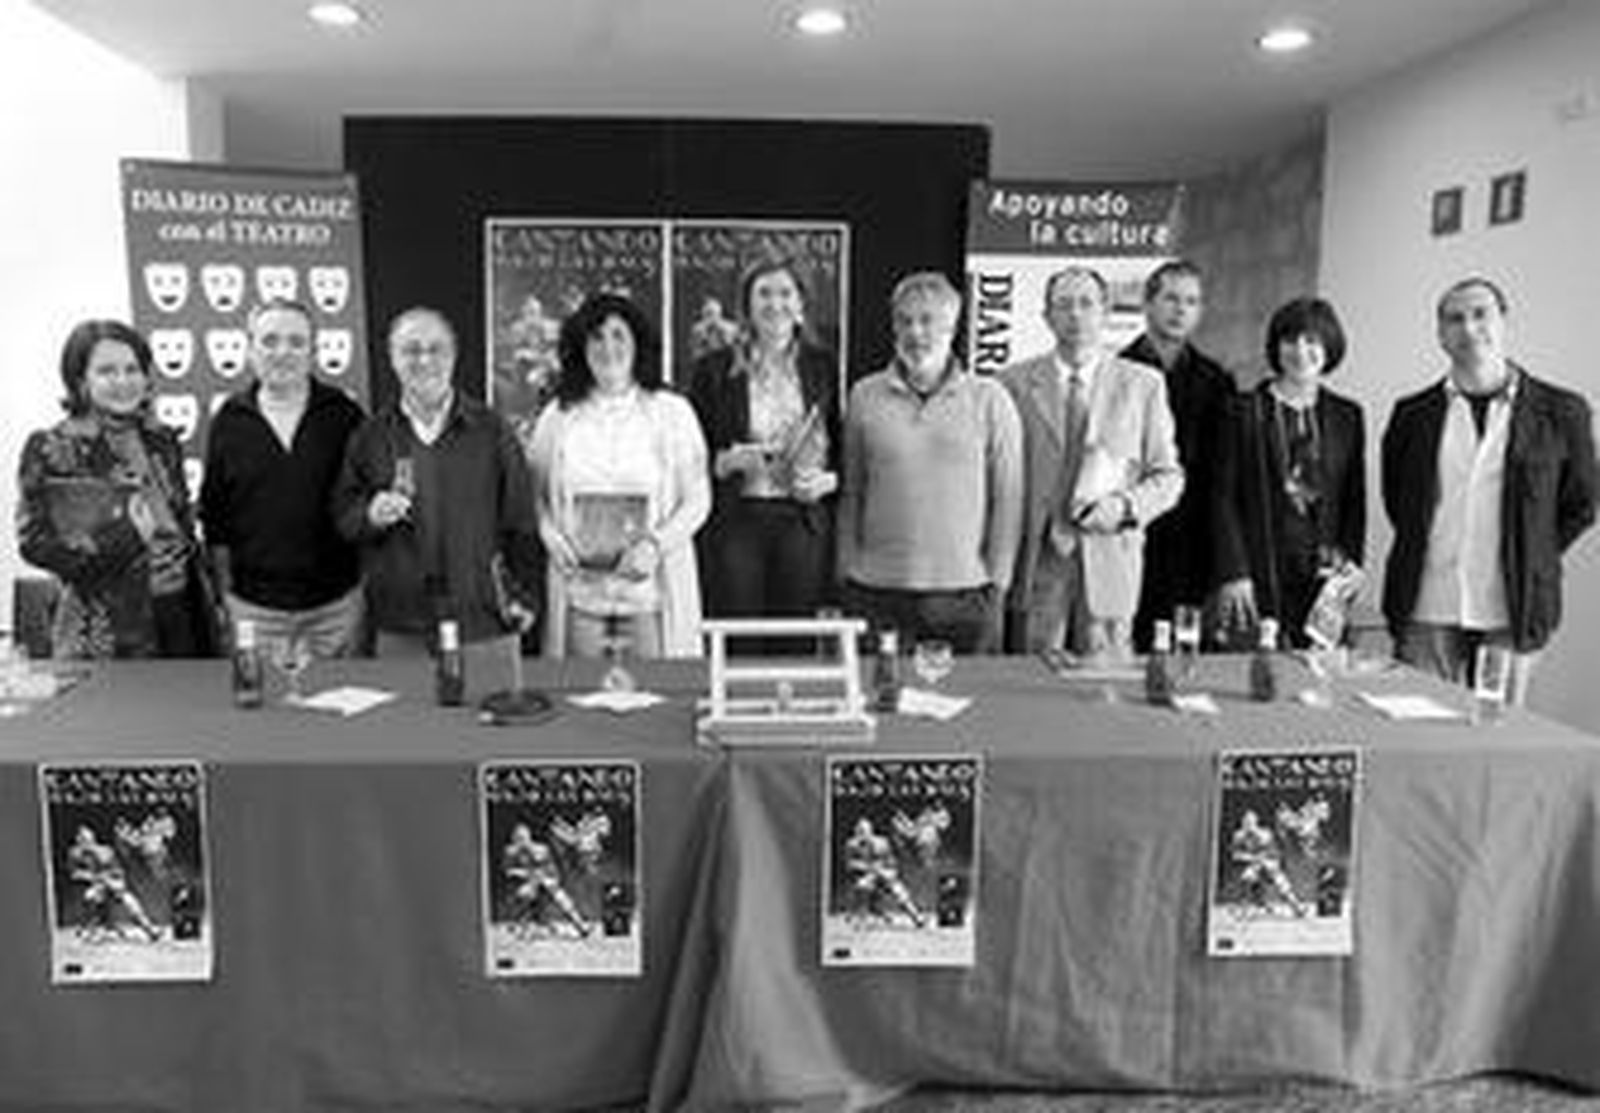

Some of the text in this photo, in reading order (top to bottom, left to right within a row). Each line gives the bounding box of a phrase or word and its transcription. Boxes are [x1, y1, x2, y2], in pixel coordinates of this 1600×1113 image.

[130, 188, 231, 214] DIARIO
[232, 192, 269, 217] DE
[988, 188, 1129, 219] Apoyando
[158, 218, 332, 244] con el TEATRO
[1030, 219, 1170, 248] la cultura
